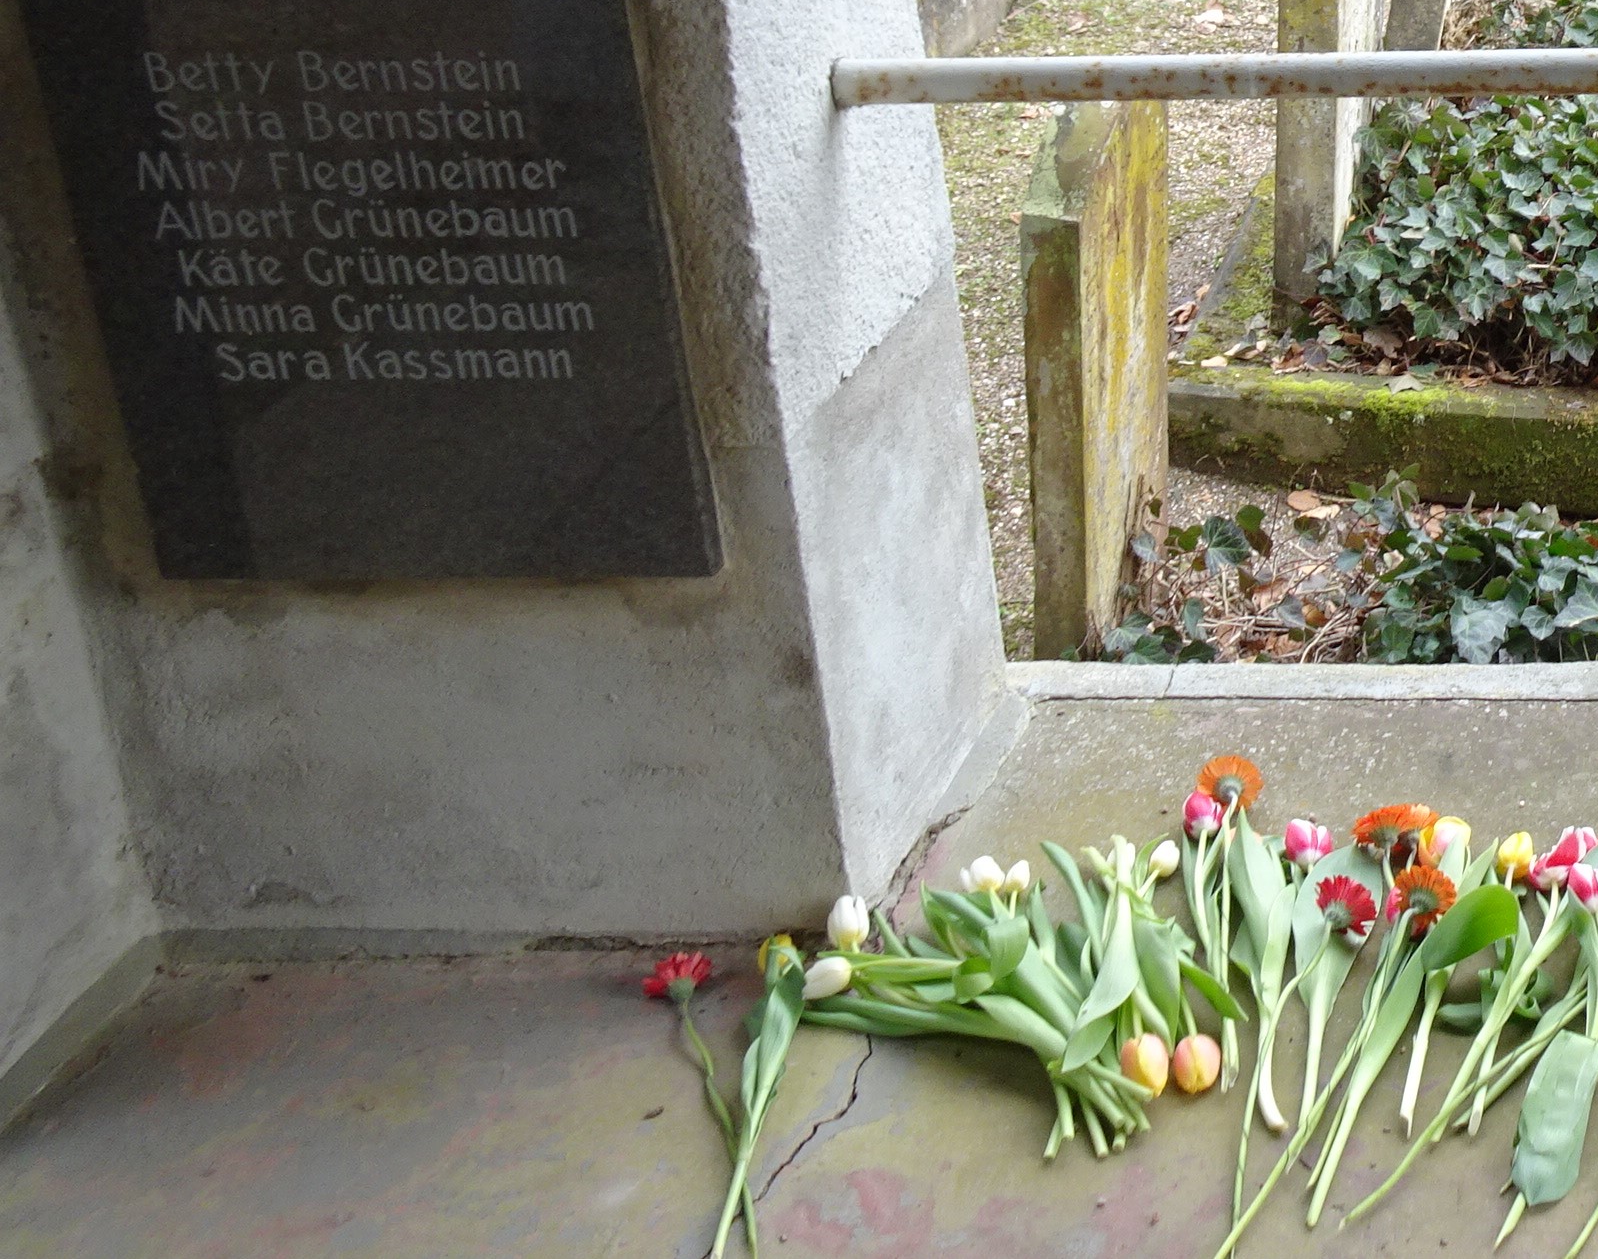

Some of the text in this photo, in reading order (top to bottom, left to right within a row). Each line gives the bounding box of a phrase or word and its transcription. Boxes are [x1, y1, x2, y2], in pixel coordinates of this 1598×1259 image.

[143, 49, 522, 95] Betty Bernstein
[154, 101, 525, 142] Setta Bernstein
[138, 150, 567, 197] Miry Flegelheimer
[155, 199, 578, 240] Albert Grünebaum
[178, 246, 567, 286] Käte Grünebaum
[175, 294, 595, 334] Minna Grünebaum
[216, 342, 574, 381] Sara Kassmann
